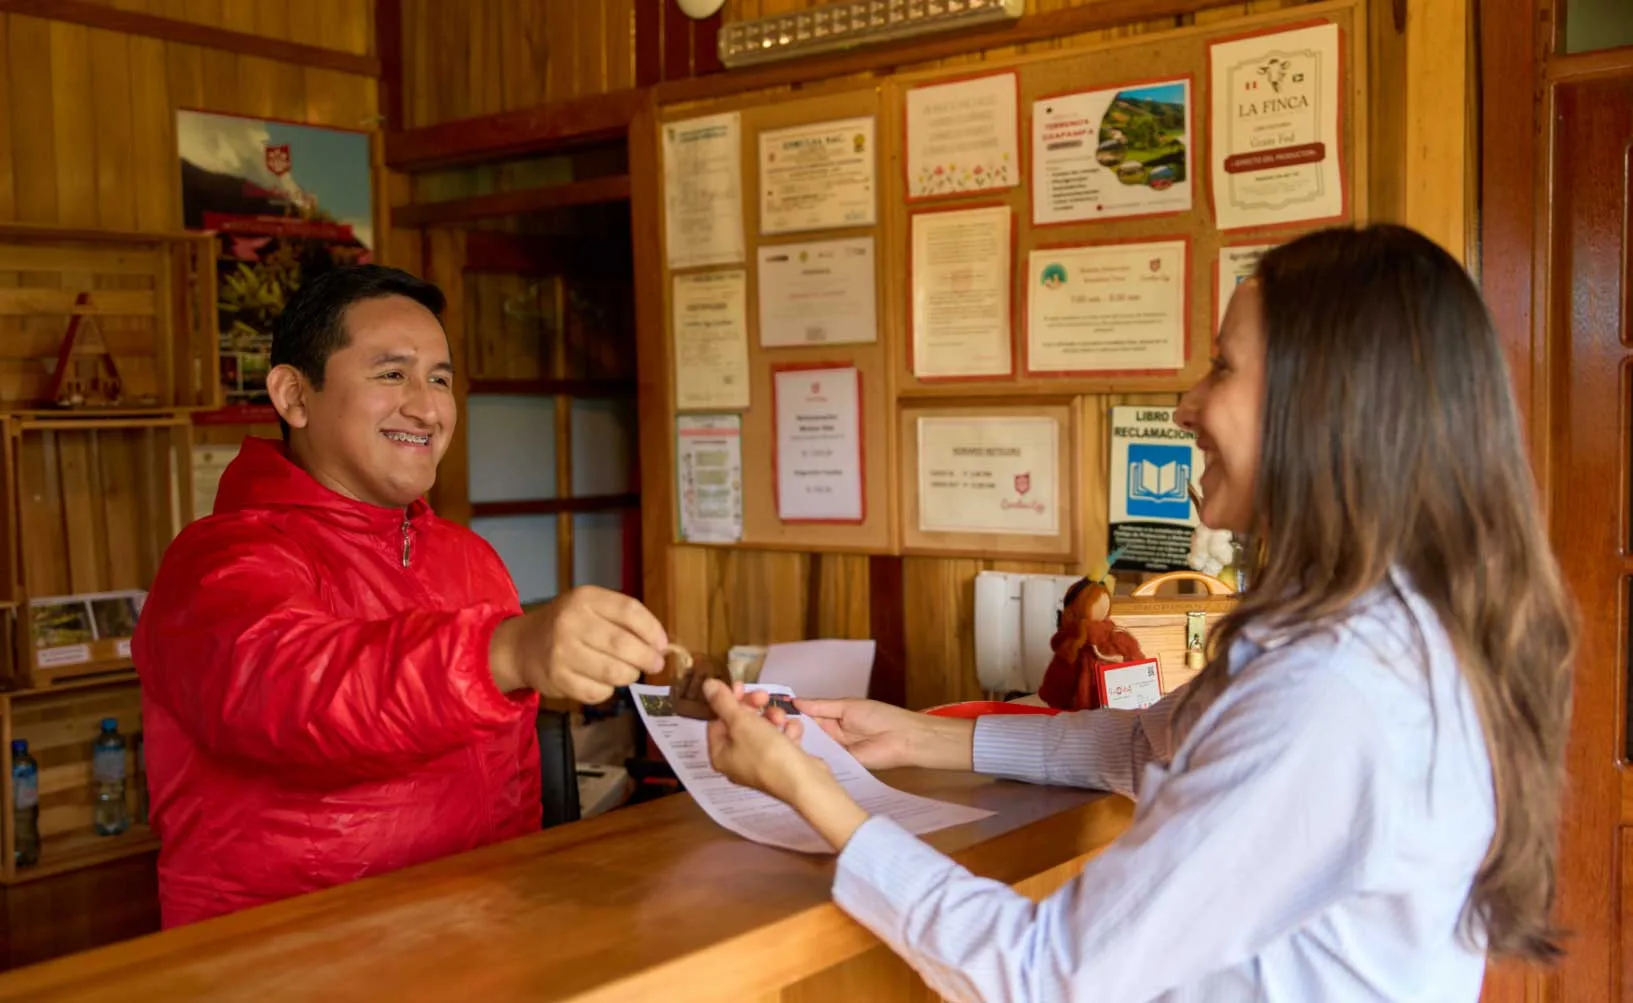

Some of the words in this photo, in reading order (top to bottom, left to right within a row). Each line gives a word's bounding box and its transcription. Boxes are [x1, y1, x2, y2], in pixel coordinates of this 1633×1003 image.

[1238, 103, 1258, 118] LA
[1263, 95, 1309, 114] FINCA
[1136, 410, 1169, 422] LIBRO
[1114, 426, 1198, 440] RECLAMACION
